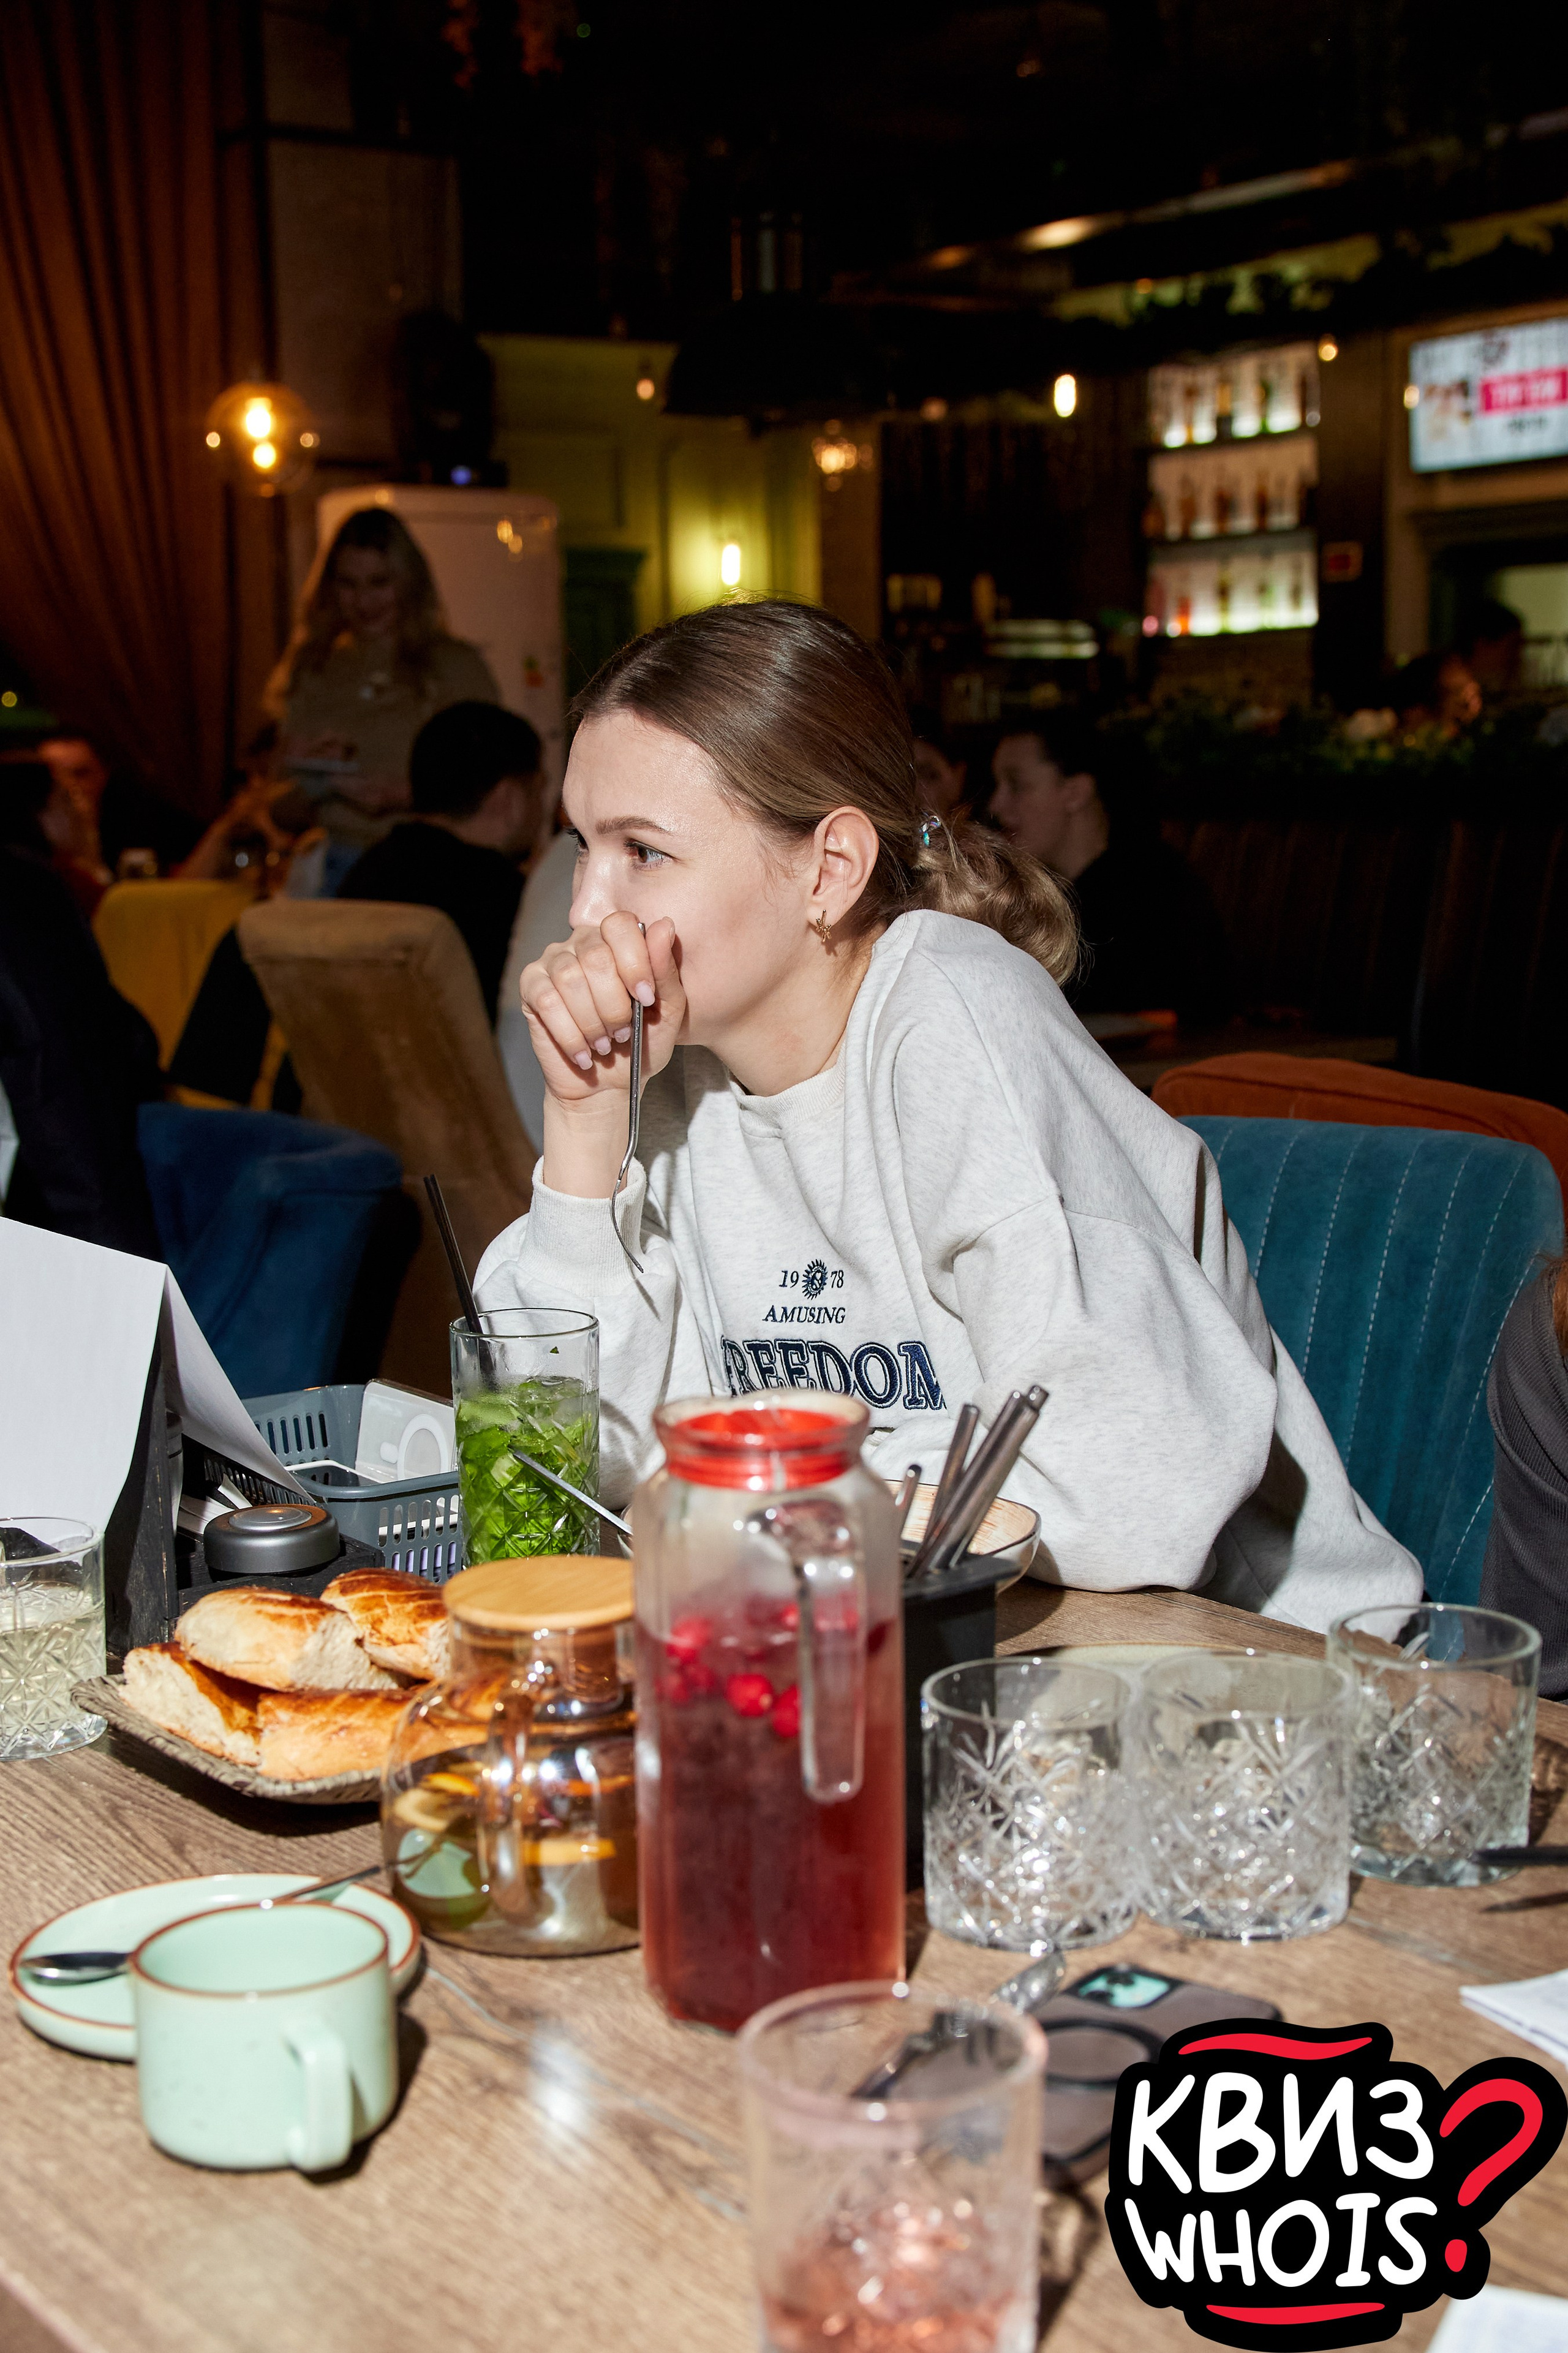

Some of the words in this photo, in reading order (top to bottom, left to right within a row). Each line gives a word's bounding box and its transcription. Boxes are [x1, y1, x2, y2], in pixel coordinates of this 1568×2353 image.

[778, 1270, 799, 1288] 19
[830, 1269, 844, 1288] 78
[762, 1305, 846, 1324] AMUSING
